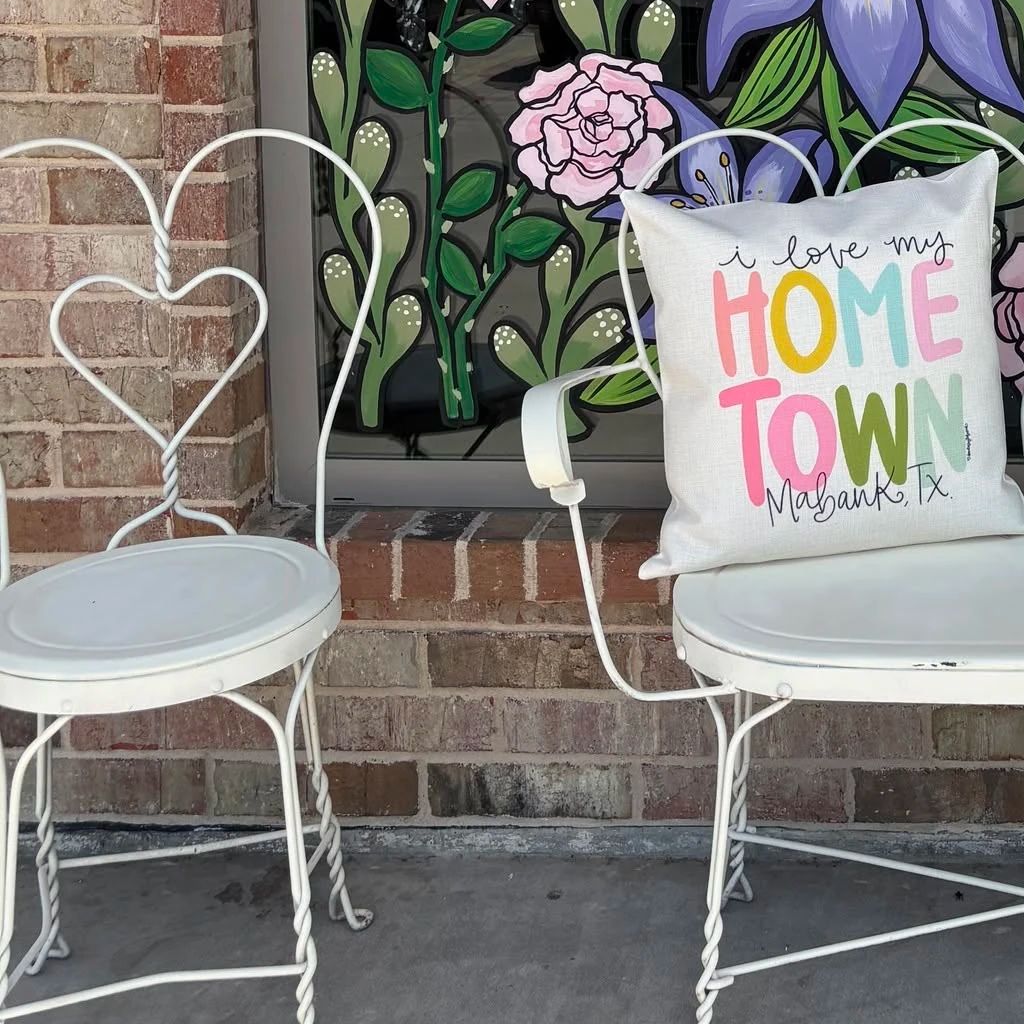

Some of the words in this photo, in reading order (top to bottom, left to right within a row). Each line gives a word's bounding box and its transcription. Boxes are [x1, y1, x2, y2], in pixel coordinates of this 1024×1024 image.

[718, 245, 756, 270] i
[772, 235, 869, 269] love
[884, 231, 954, 266] my
[712, 258, 964, 378] HOME
[718, 373, 968, 508] TOWN
